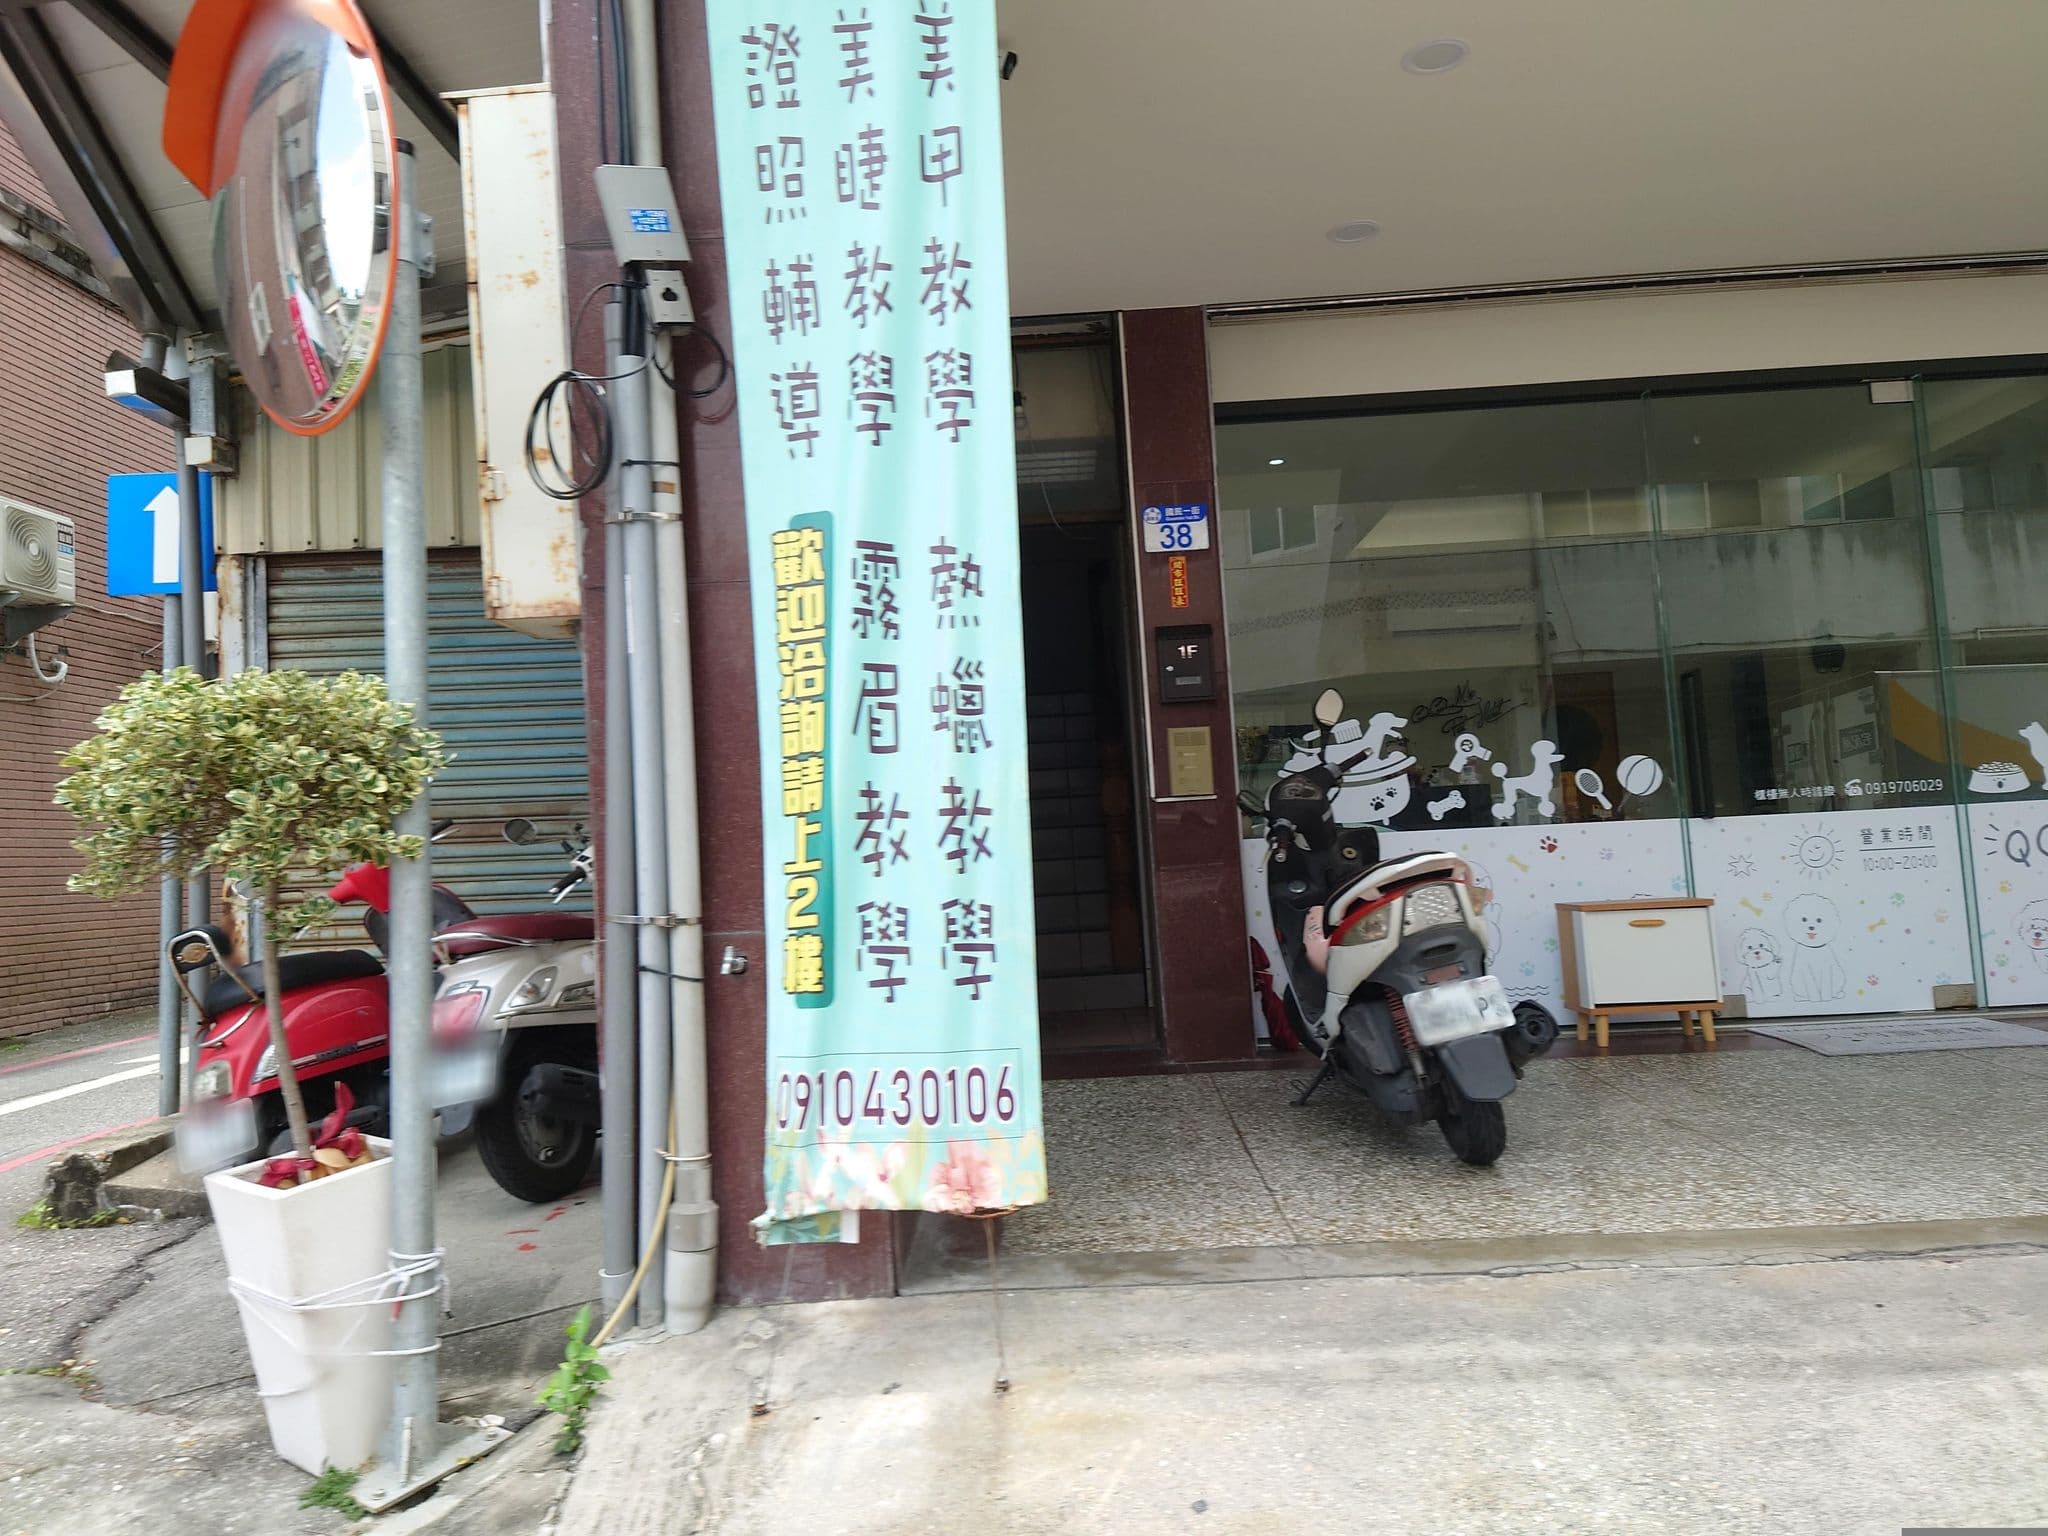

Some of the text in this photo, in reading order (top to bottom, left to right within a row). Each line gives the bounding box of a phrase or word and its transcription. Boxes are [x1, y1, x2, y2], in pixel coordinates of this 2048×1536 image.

[740, 22, 821, 459] 證照輔導
[832, 7, 911, 1003] 美睫教學 霧眉教學
[914, 0, 997, 1001] 美甲教學 熱蠟教學
[1160, 524, 1192, 549] 38
[1177, 645, 1199, 659] 1F
[772, 526, 825, 994] 歡迎洽詢請上2樓
[1865, 779, 1943, 795] 0919706029
[1860, 825, 1933, 845] 營業時間
[1863, 855, 1937, 872] 10:00-20:00
[777, 1065, 1015, 1130] 0910430106
